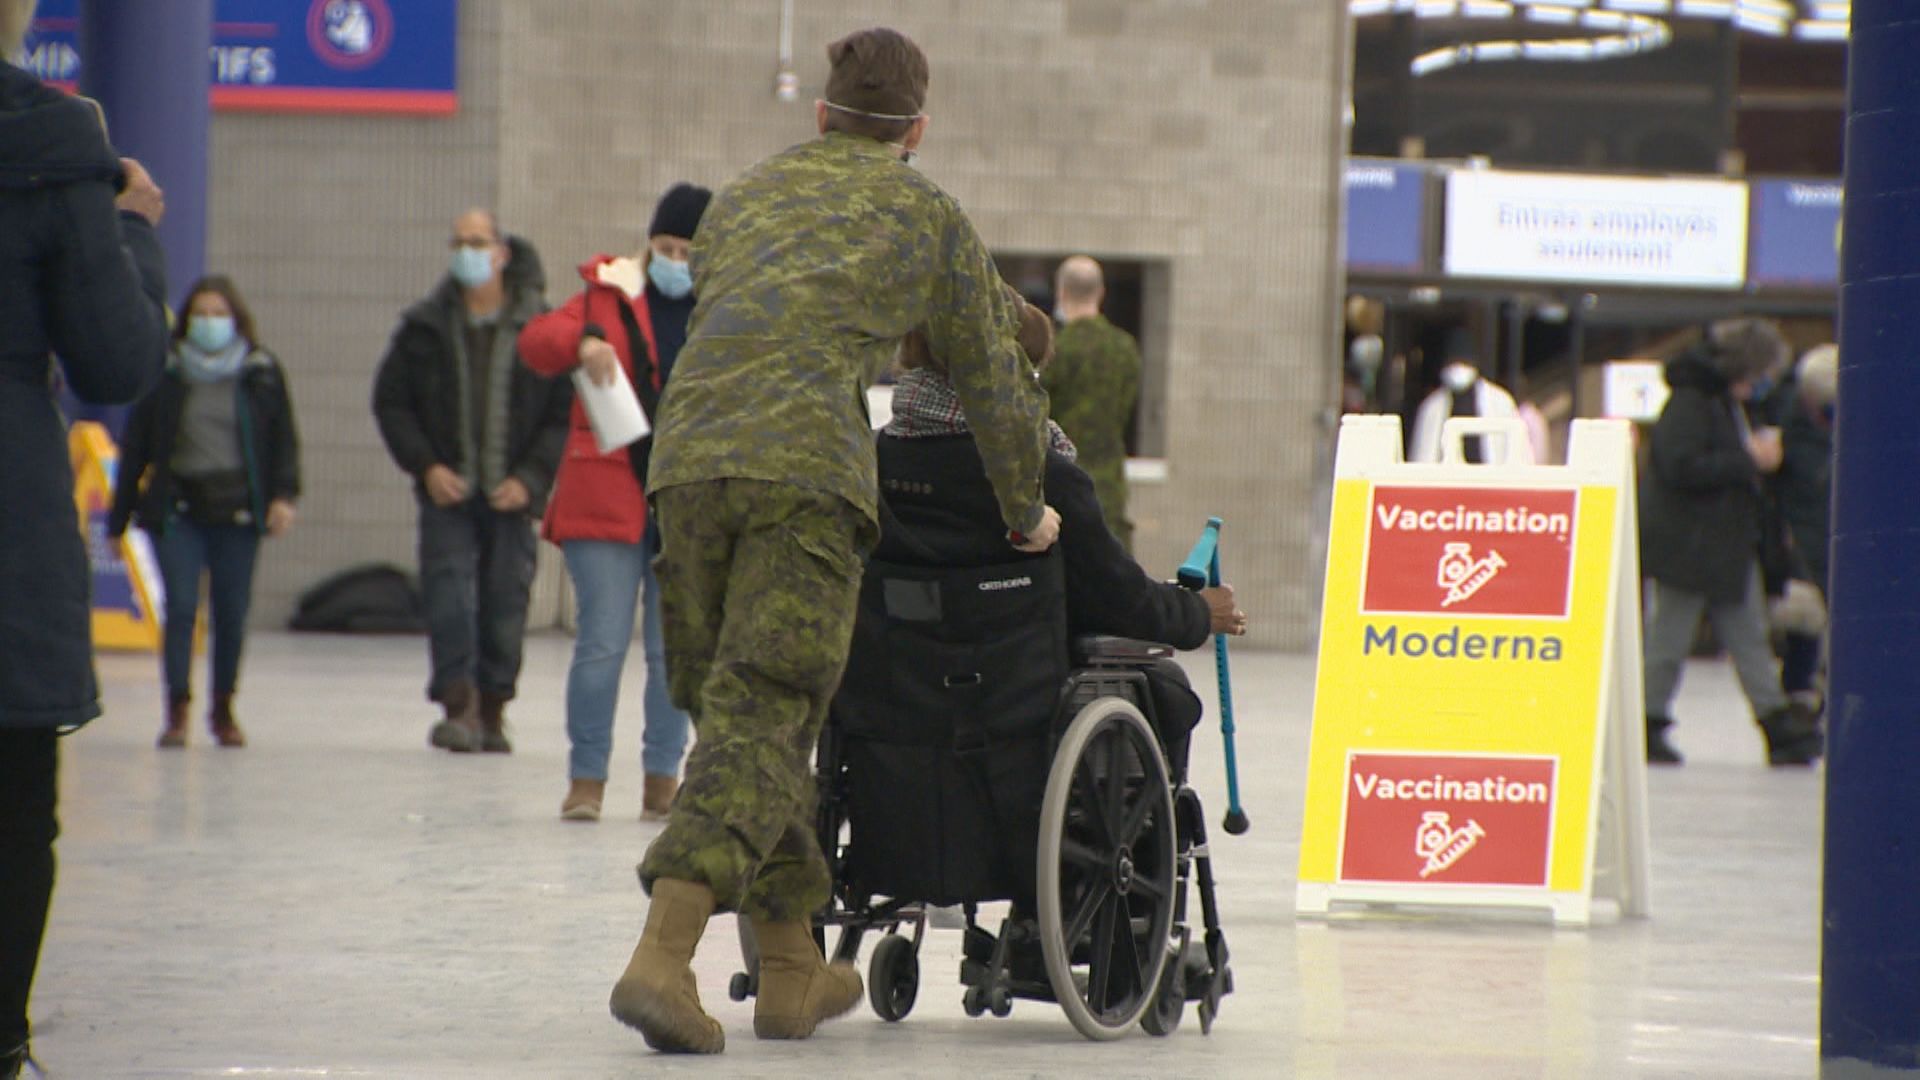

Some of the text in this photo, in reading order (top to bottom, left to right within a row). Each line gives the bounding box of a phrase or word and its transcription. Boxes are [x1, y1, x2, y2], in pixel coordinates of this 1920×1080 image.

[1376, 504, 1569, 534] Vaccination
[1363, 625, 1563, 661] Moderna
[1353, 773, 1548, 803] Vaccination
